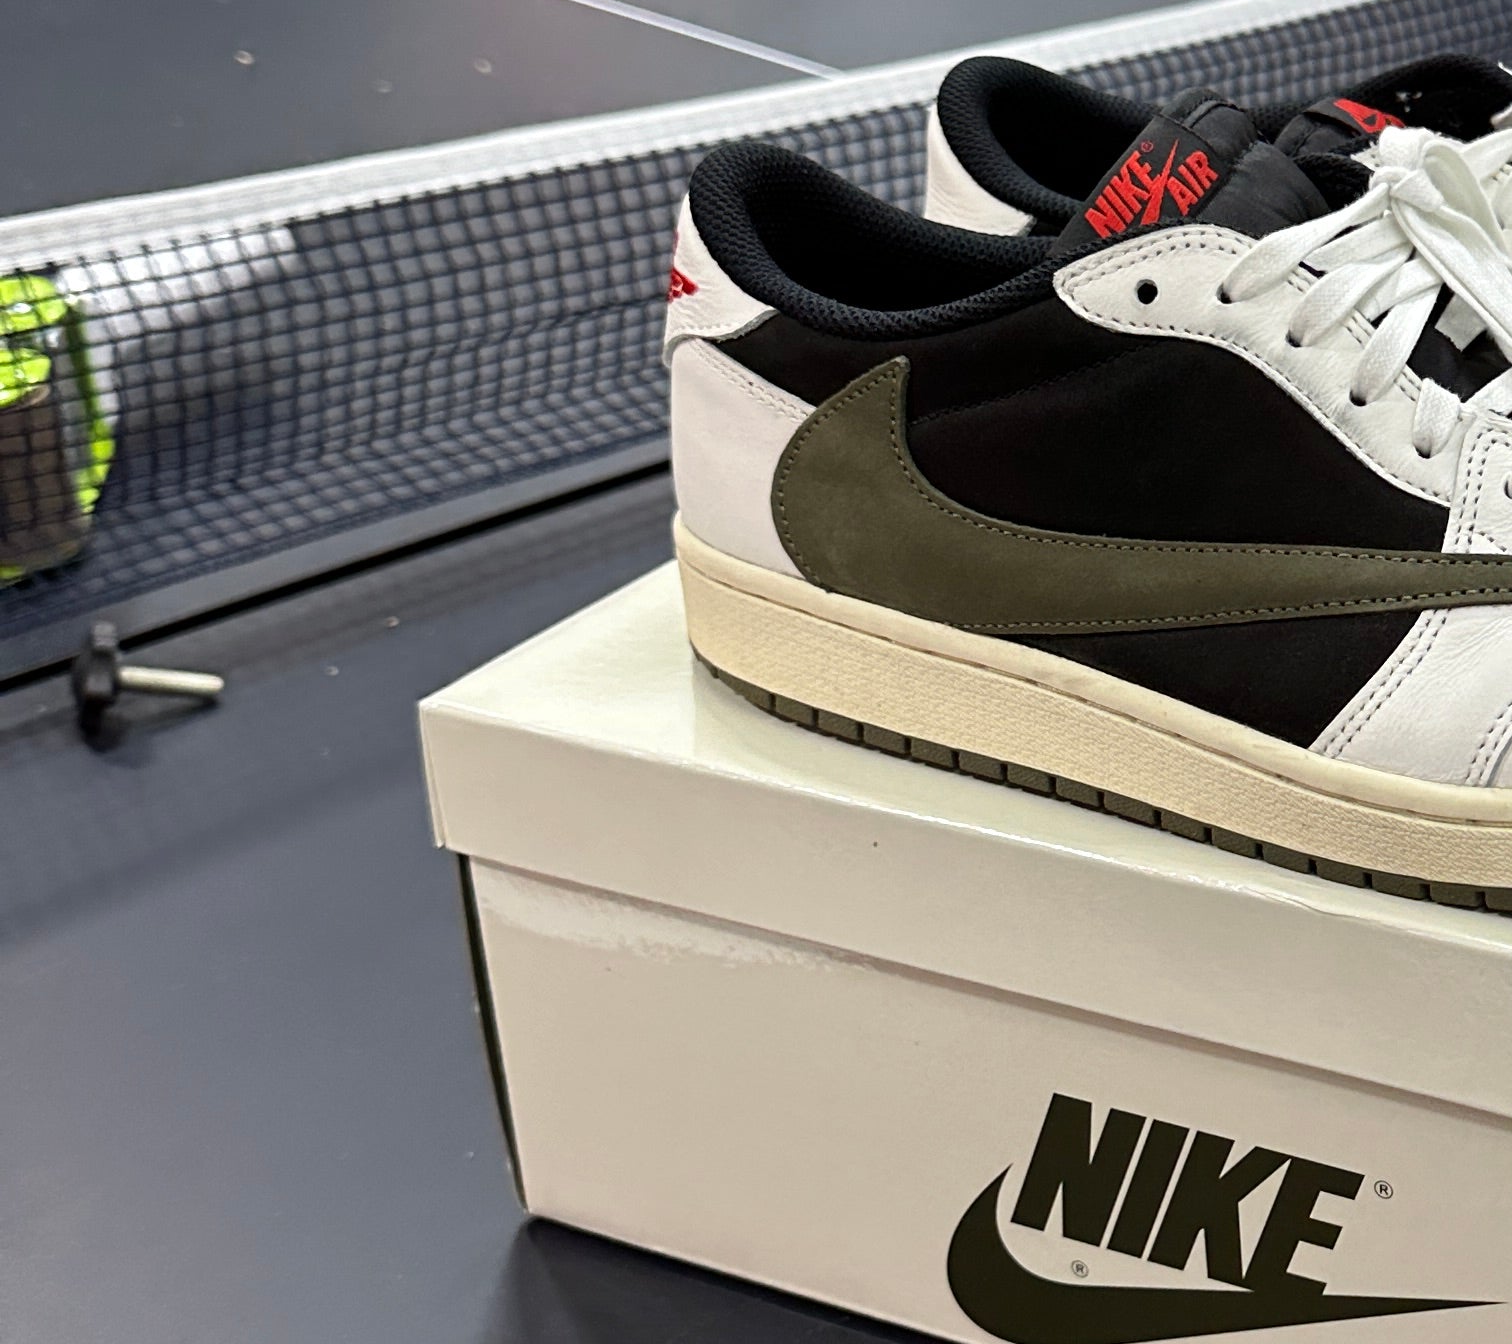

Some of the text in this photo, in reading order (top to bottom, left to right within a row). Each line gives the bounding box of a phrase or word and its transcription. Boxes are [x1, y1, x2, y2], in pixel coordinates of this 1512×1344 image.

[1085, 150, 1219, 239] NIKE AIR
[1010, 1092, 1365, 1296] NIKE
